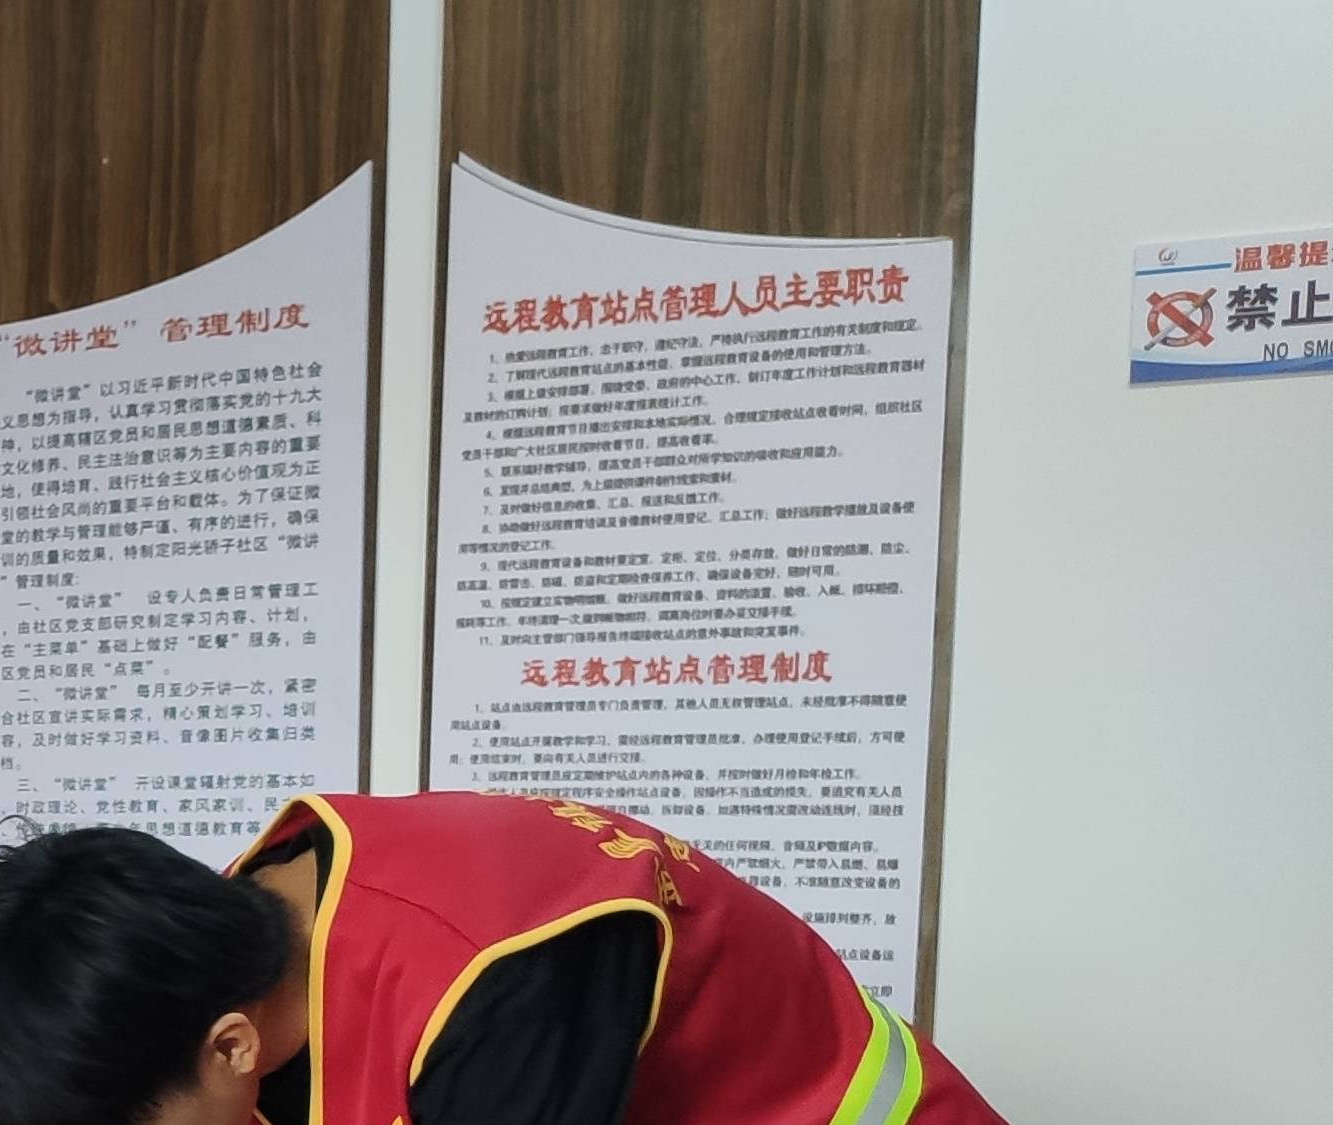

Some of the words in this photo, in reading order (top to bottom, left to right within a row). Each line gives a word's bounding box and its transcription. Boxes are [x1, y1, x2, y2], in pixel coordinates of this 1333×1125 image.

[1233, 240, 1333, 273] 温馨提
[482, 264, 909, 334] 远程教育站点管理人员主要职责
[1226, 279, 1333, 332] 禁止
[1263, 342, 1289, 361] NO
[520, 649, 832, 687] 远程教育站点管理制度
